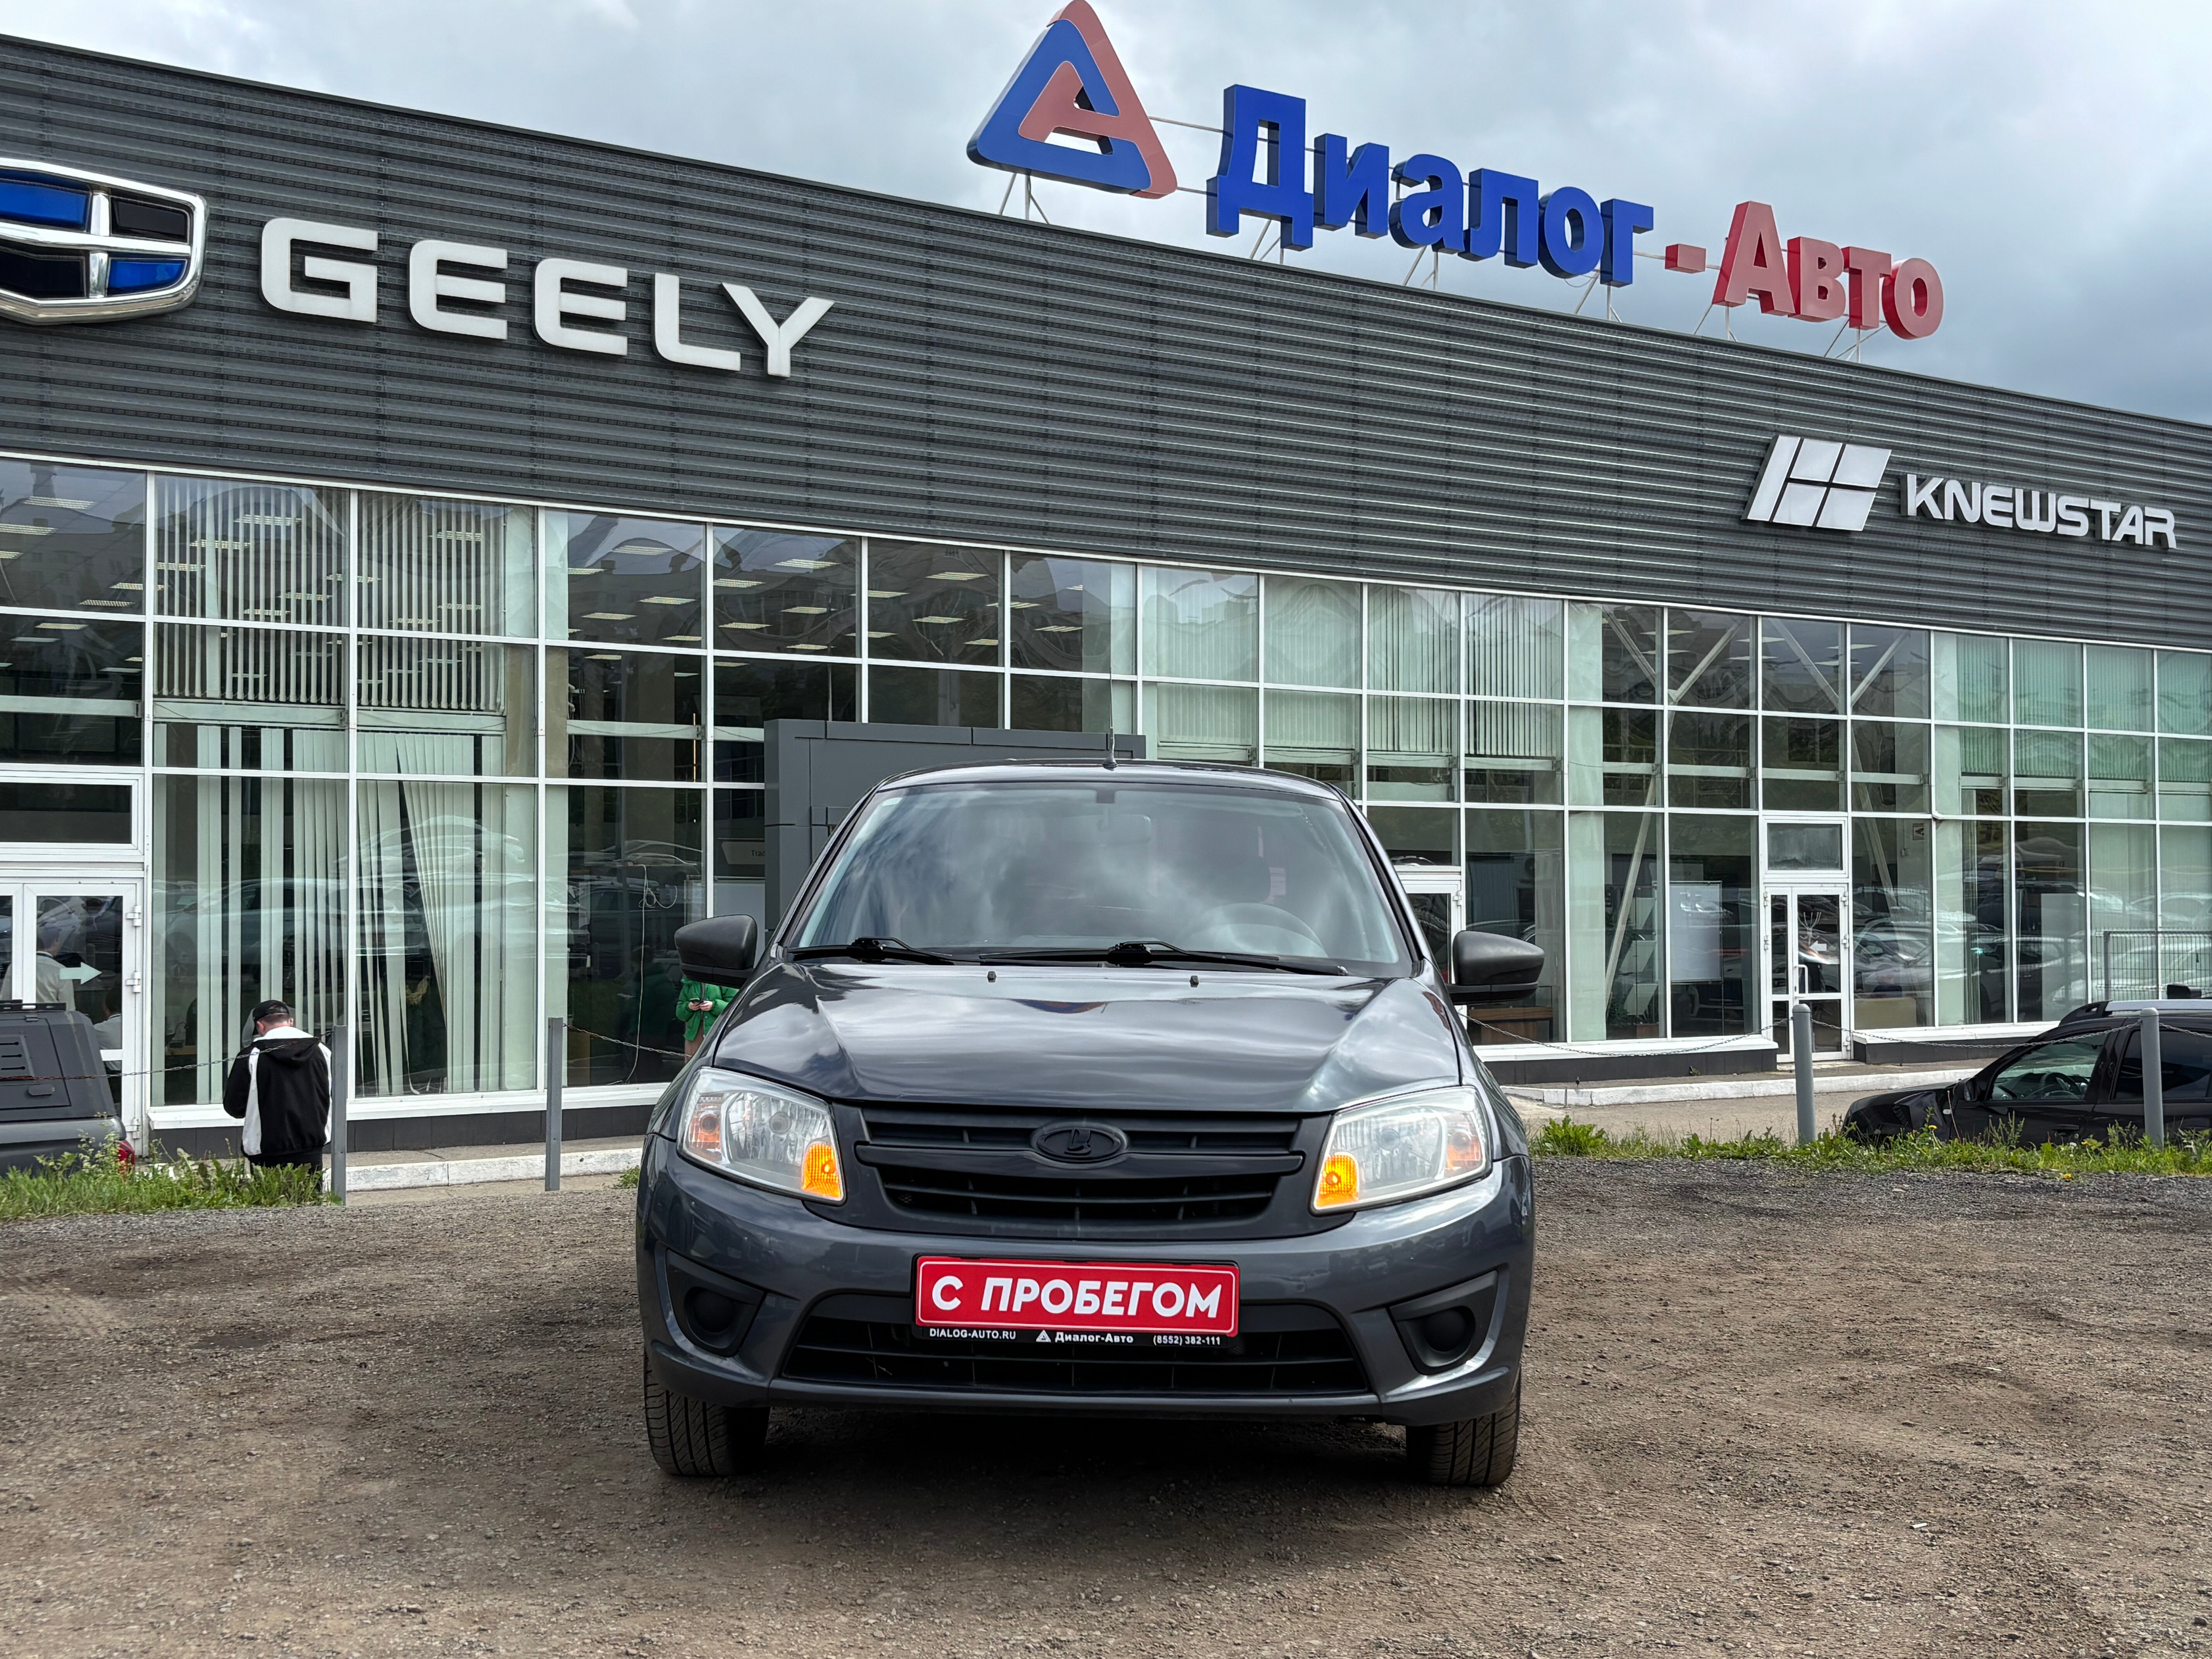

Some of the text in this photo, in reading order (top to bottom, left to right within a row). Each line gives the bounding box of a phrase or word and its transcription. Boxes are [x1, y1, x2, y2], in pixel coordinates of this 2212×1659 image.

[259, 217, 835, 378] GEELY
[1902, 474, 2177, 549] KNEWSTAR
[932, 1275, 1222, 1318] С ПРОБЕГОМ
[929, 1328, 1016, 1340] DIALOG-AUTO.RU
[1054, 1331, 1133, 1343] Диалог-Авто
[1153, 1335, 1221, 1346] (8552) 382-111
